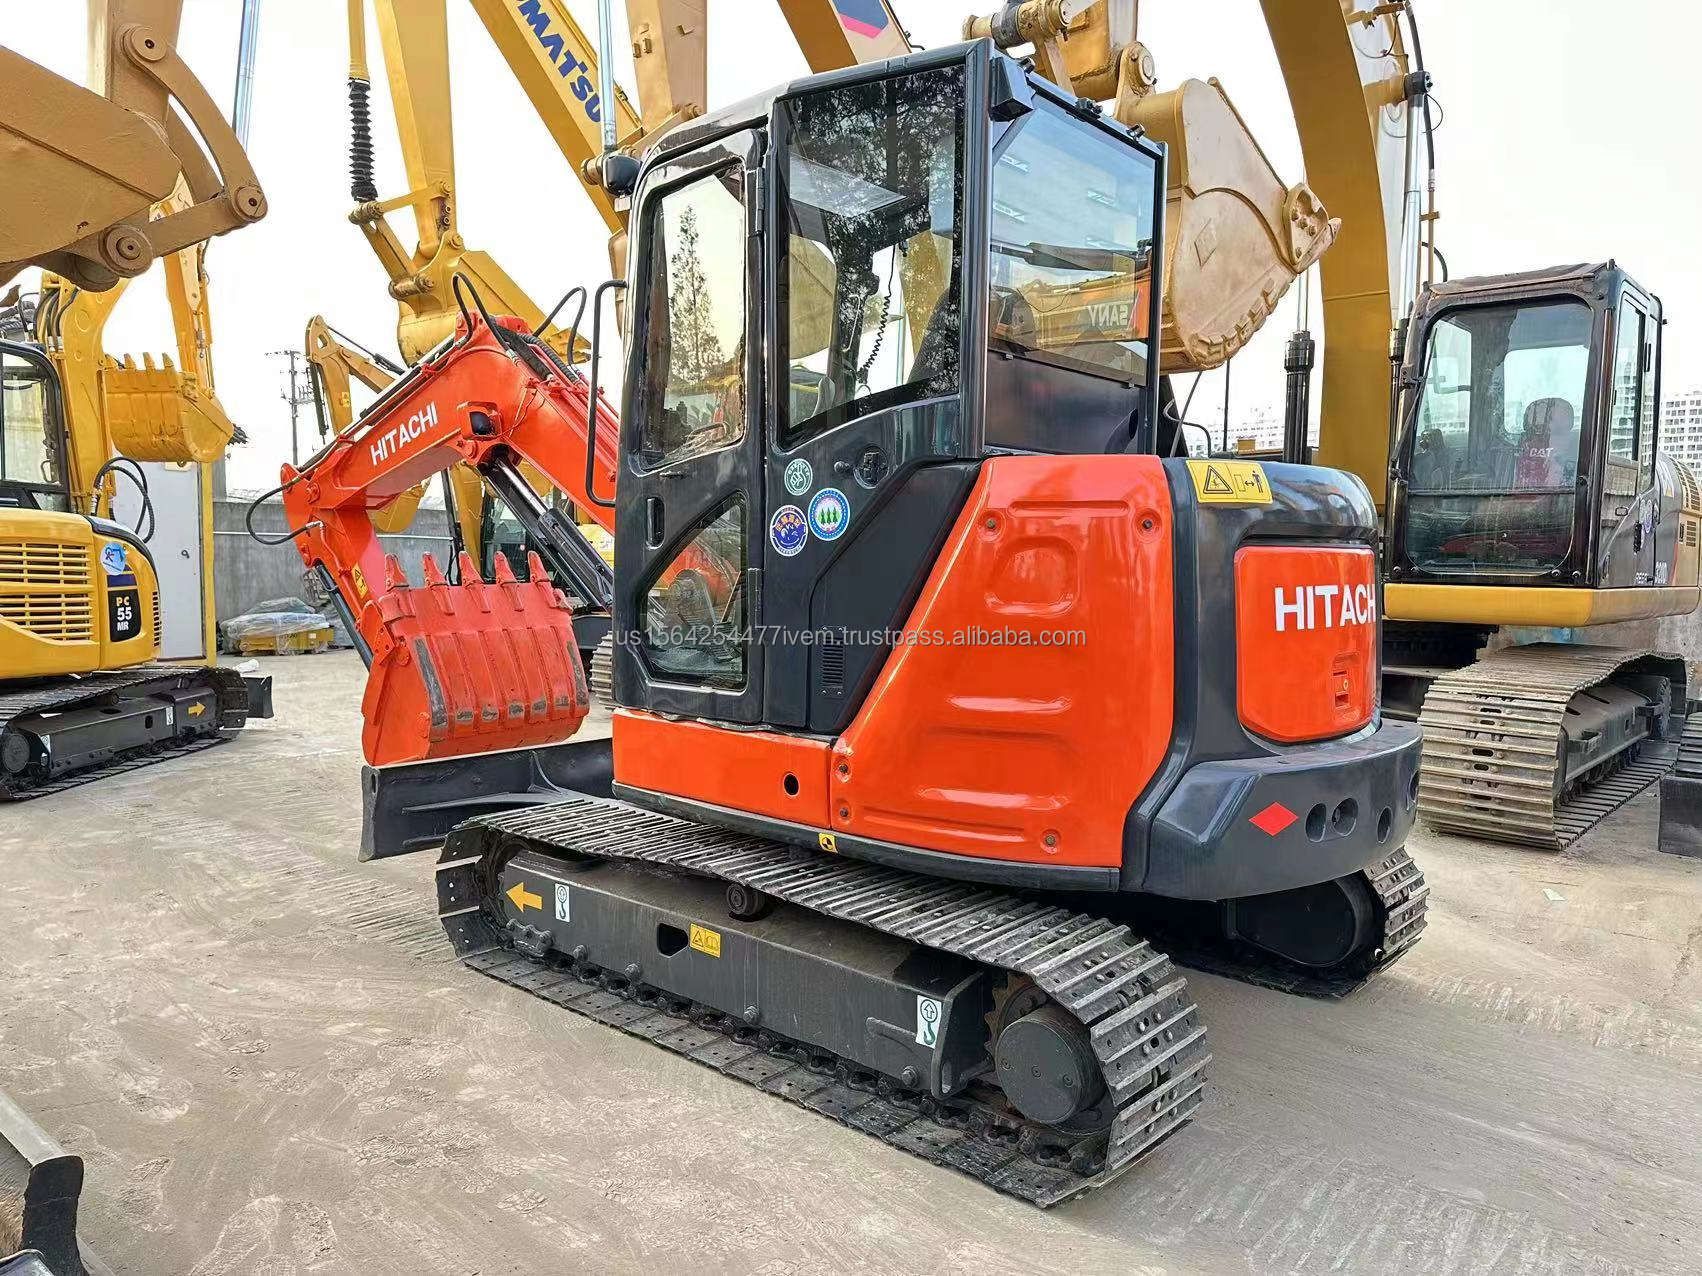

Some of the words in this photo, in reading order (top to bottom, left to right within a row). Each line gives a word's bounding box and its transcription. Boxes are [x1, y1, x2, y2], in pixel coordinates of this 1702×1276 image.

[517, 0, 600, 122] MATSU
[370, 401, 438, 466] HITACHI
[116, 597, 129, 607] PC
[117, 607, 132, 620] 55
[117, 621, 129, 631] MR
